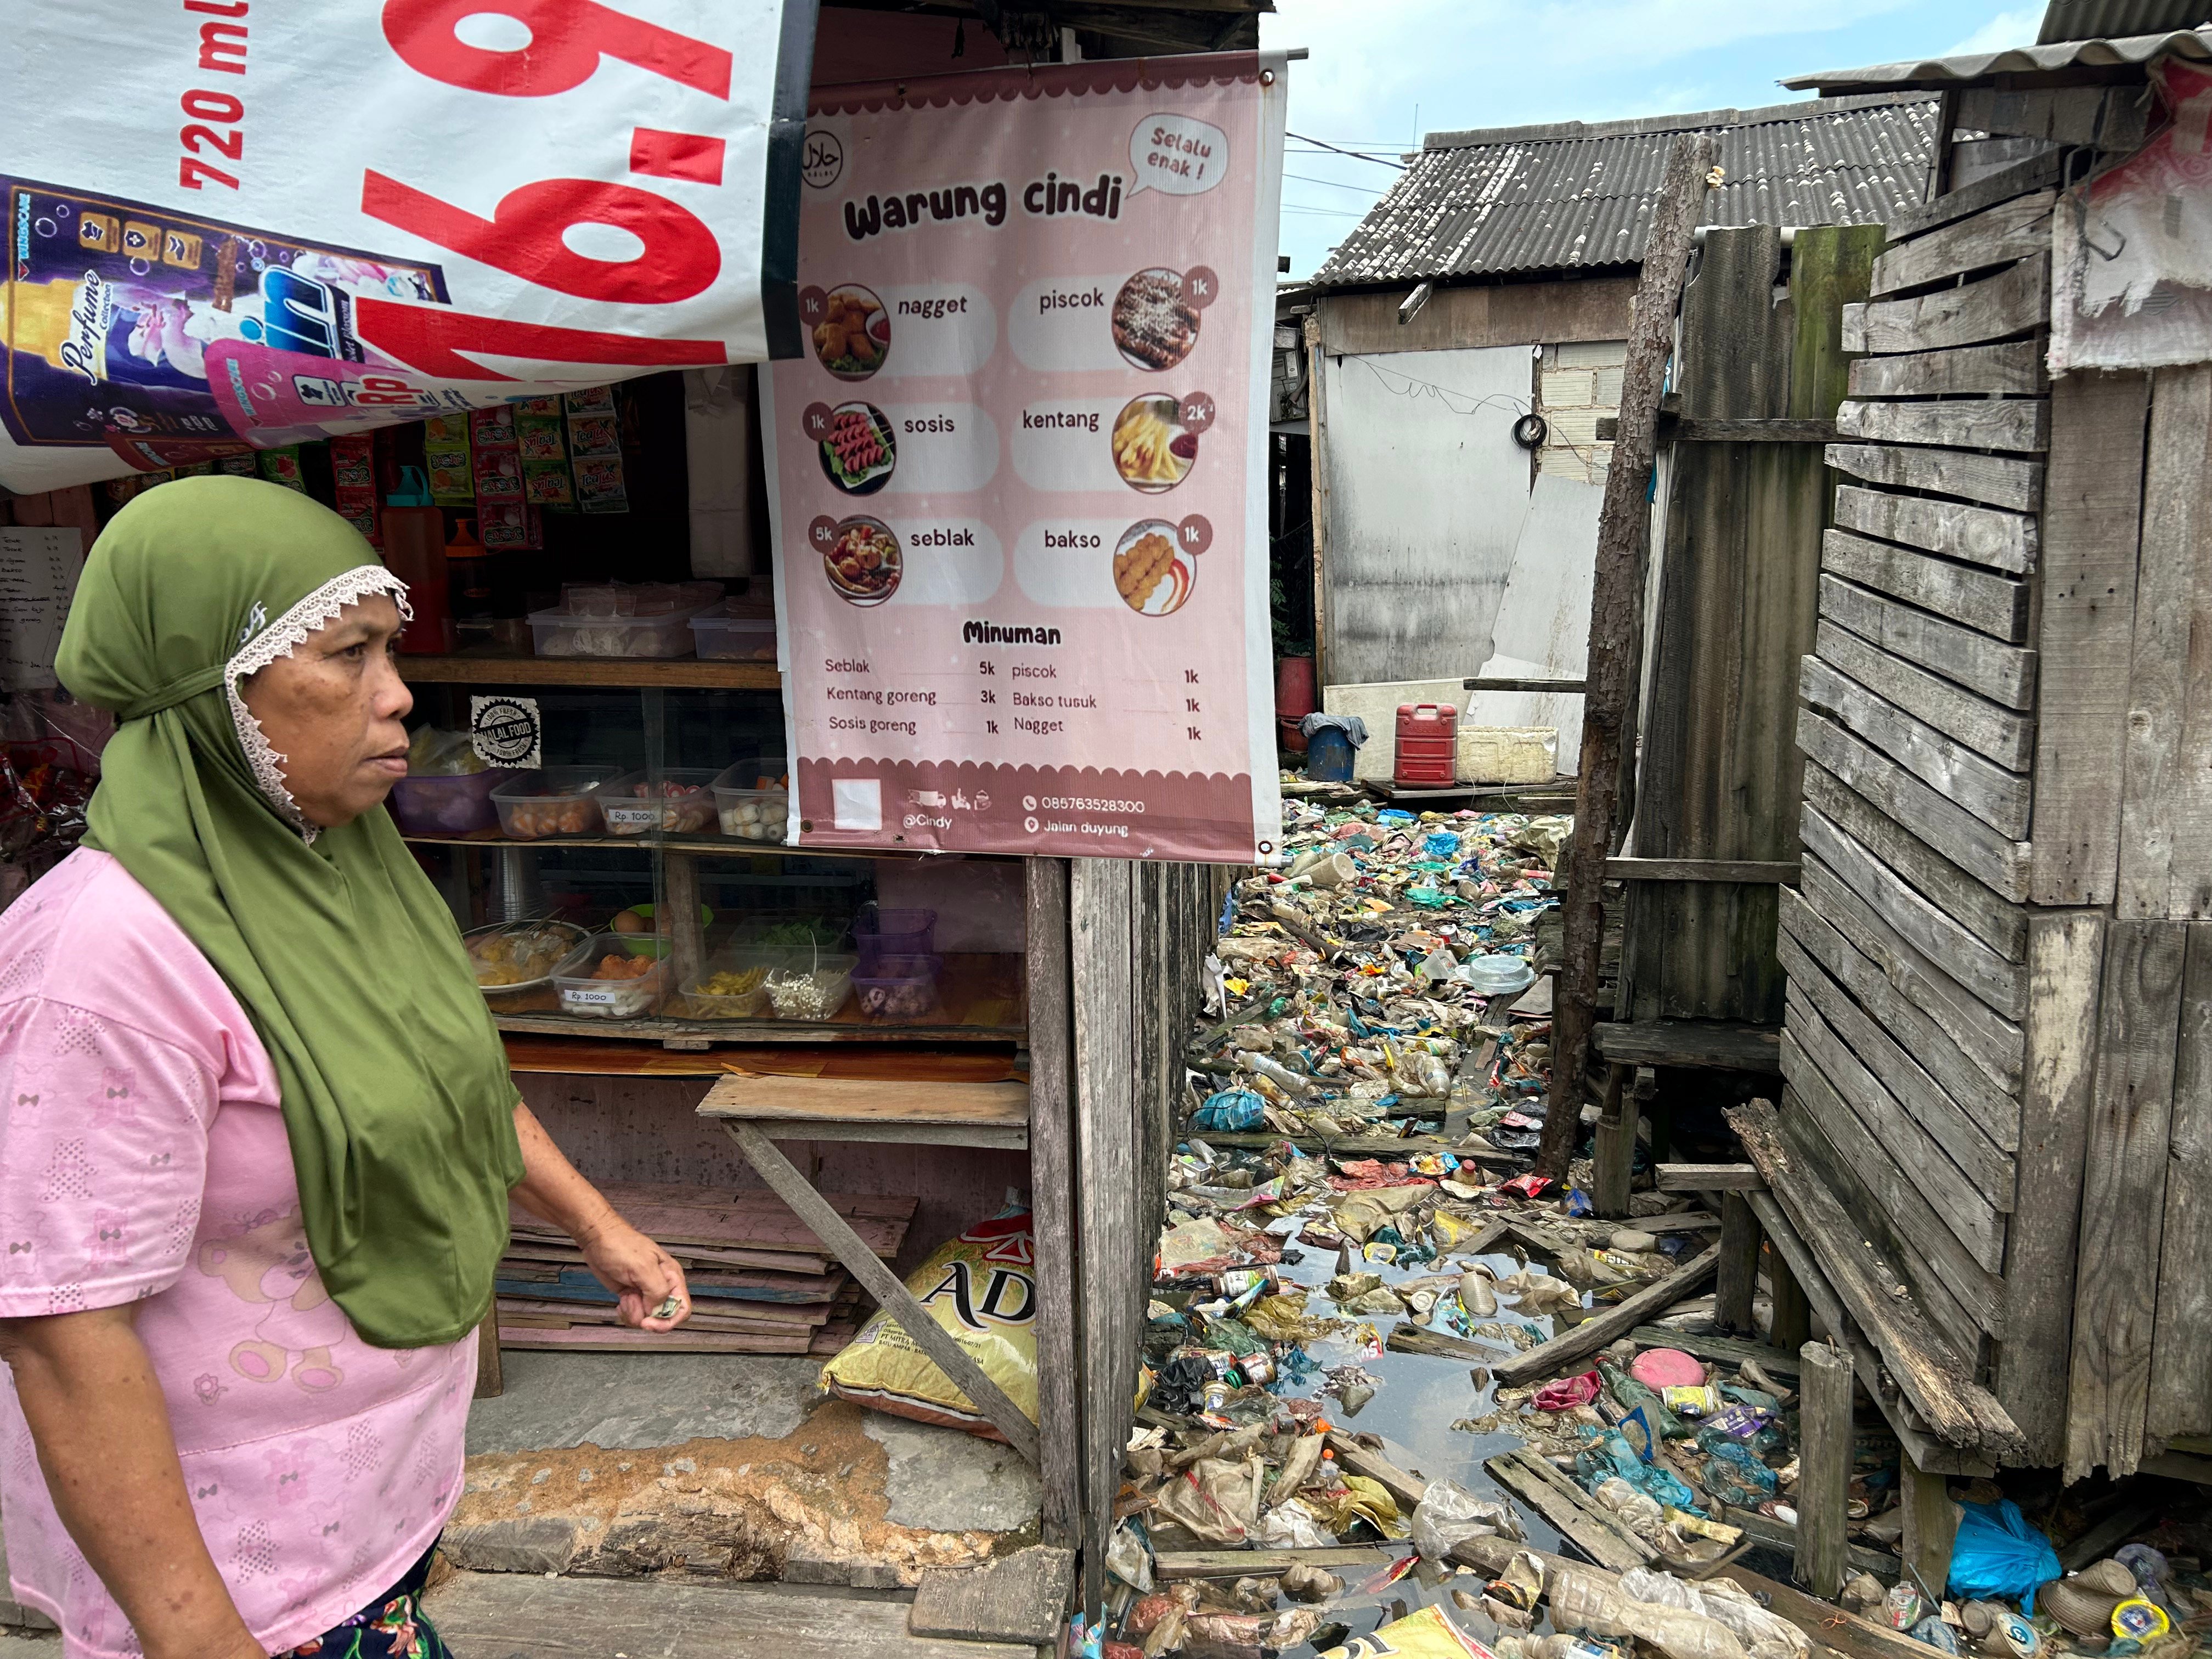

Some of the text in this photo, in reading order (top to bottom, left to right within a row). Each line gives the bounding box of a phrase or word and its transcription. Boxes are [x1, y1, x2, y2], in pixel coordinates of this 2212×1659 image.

[180, 0, 249, 190] 720 ml
[1150, 126, 1212, 158] Selalu
[1147, 154, 1205, 180] enak !
[844, 171, 1122, 241] Warung cindi
[1193, 278, 1208, 295] 1k
[99, 284, 112, 331] Collection
[806, 297, 819, 313] 1k
[898, 297, 967, 319] nagget
[1040, 289, 1105, 313] piscok
[61, 270, 100, 385] Perfume
[355, 376, 424, 405] Rp
[811, 414, 825, 429] 1k
[1023, 409, 1100, 433] kentang
[1187, 404, 1206, 420] 2k
[904, 414, 955, 433] sosis
[816, 526, 833, 541] 5k
[911, 528, 975, 547] seblak
[1045, 529, 1101, 548] bakso
[1184, 525, 1200, 542] 1k
[963, 620, 1062, 645] Minuman
[825, 658, 996, 675] Seblak 5k
[1012, 662, 1199, 684] piscok 1k
[827, 687, 996, 706] Kentang goreng 3k
[1013, 692, 1201, 713] Bakso tusuk 1k
[508, 721, 532, 737] FOOD
[829, 715, 999, 736] Sosis goreng 1k
[1014, 716, 1202, 741] Nagget 1k
[631, 812, 653, 820] 1000
[903, 814, 953, 830] @Cindy
[1043, 820, 1130, 838] Jalan duyung
[585, 993, 607, 1001] 1000
[919, 1261, 1036, 1329] AD
